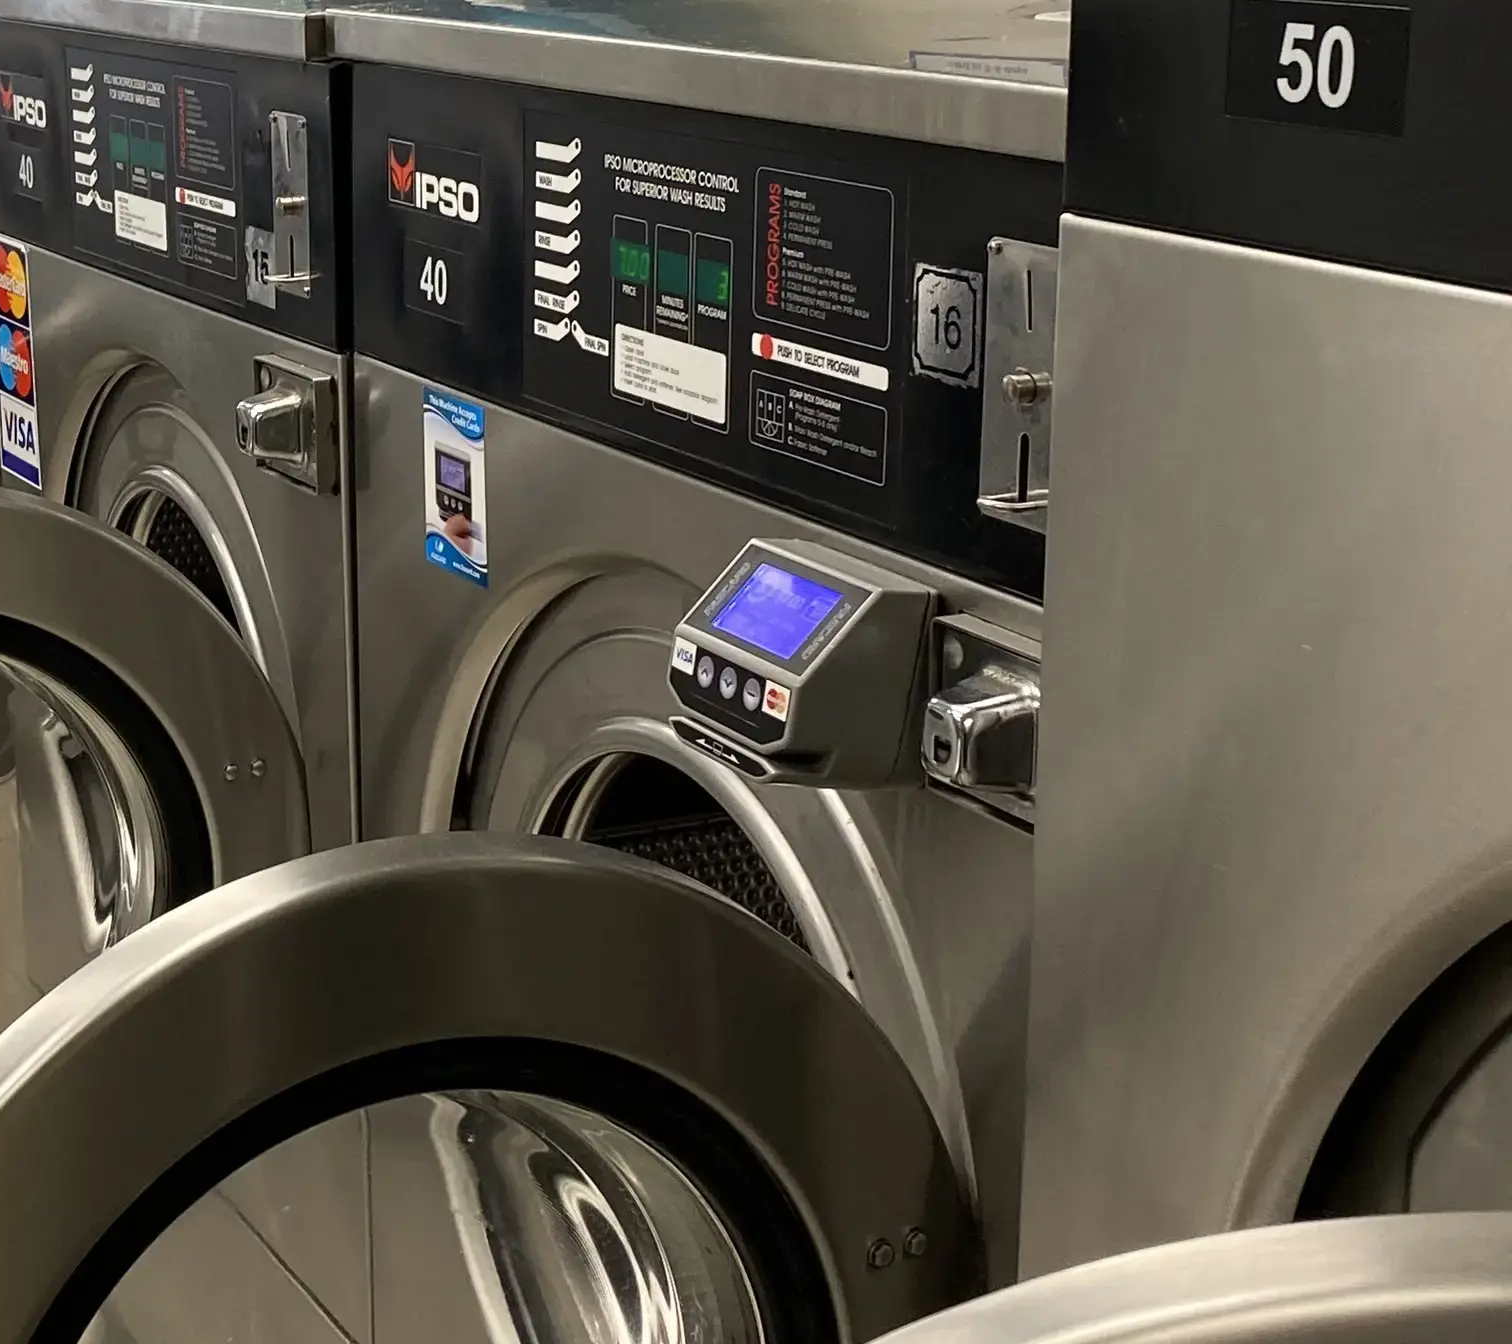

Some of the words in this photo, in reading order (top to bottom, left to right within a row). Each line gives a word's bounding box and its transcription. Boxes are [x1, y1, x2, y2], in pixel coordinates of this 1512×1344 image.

[1276, 22, 1356, 109] 50
[13, 94, 47, 129] IPSO
[19, 154, 34, 189] 40
[604, 154, 621, 170] IPSO
[622, 157, 697, 186] MICROPROCESSOR
[698, 171, 739, 193] CONTROL
[415, 171, 480, 224] IPSO
[615, 176, 631, 193] FOR
[632, 181, 668, 202] SUPERIOR
[669, 187, 693, 206] WASH
[694, 192, 726, 213] RESULTS
[766, 183, 782, 306] PROGRAMS
[252, 249, 269, 284] 15
[419, 256, 448, 305] 40
[621, 283, 637, 297] PRICE
[697, 303, 727, 321] PROGRAM
[930, 303, 961, 350] 16
[0, 345, 29, 375] Maestro
[777, 344, 792, 359] PUSH
[794, 348, 803, 362] TO
[804, 350, 826, 368] SELECT
[826, 356, 860, 378] PROGRAM
[3, 408, 36, 456] VISA
[676, 646, 694, 665] VISA
